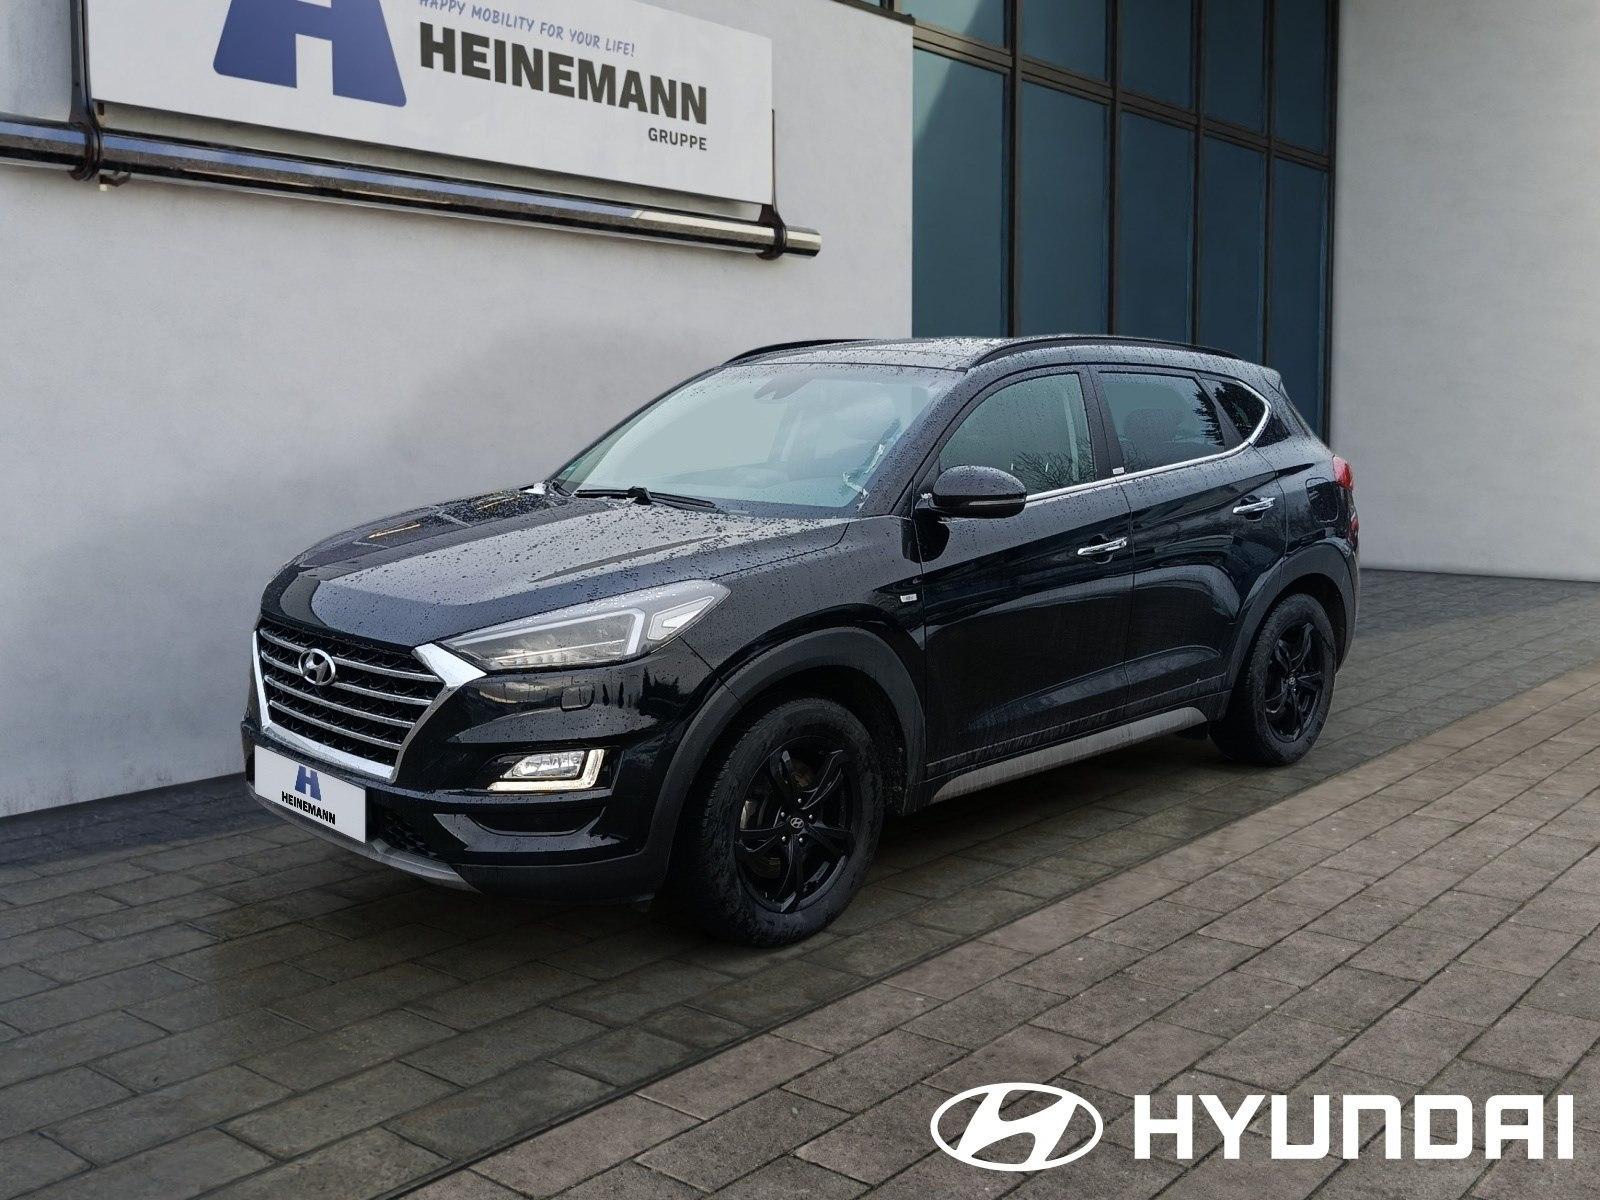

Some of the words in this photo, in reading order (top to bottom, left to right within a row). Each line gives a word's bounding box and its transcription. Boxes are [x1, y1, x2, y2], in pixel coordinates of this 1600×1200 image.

[471, 5, 535, 32] MOBILITY
[540, 21, 564, 41] FOR
[569, 28, 601, 49] YOUR
[605, 38, 635, 57] LIFE!
[420, 21, 707, 124] HEINEMANN
[648, 127, 708, 151] GRUPPE
[281, 791, 335, 825] HEINEMANN
